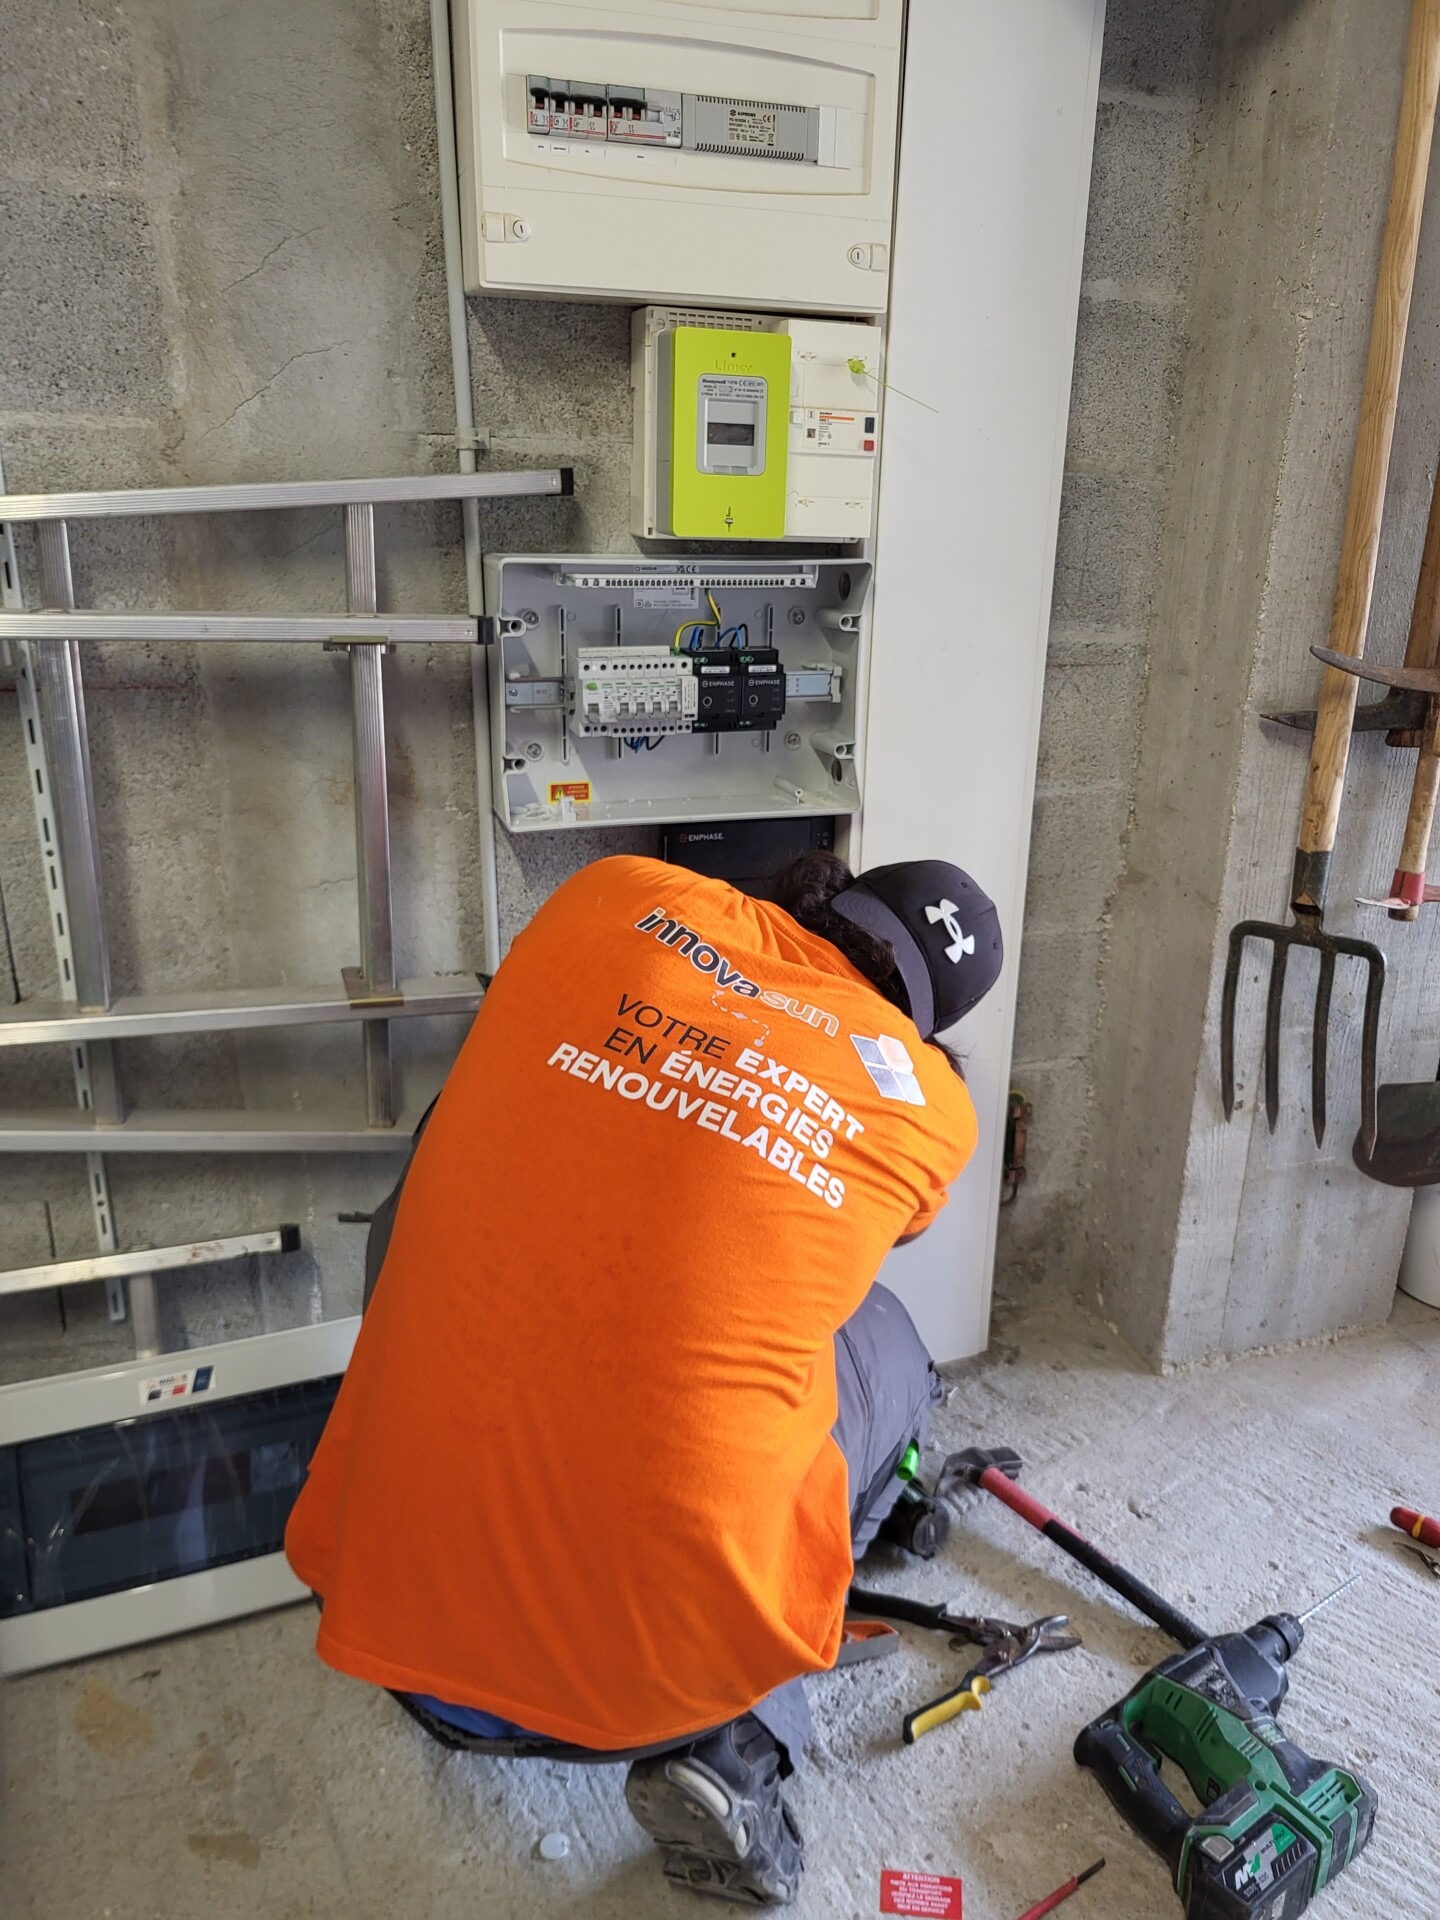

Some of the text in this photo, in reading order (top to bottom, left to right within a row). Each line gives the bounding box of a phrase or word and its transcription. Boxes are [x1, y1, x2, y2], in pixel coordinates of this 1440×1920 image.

[688, 833, 726, 842] ENPHASE
[634, 906, 840, 1038] innovasun
[547, 1042, 846, 1209] RENOUVELABLES
[603, 1027, 834, 1159] EN ÉNERGIES
[617, 993, 865, 1141] VOTRE EXPERT
